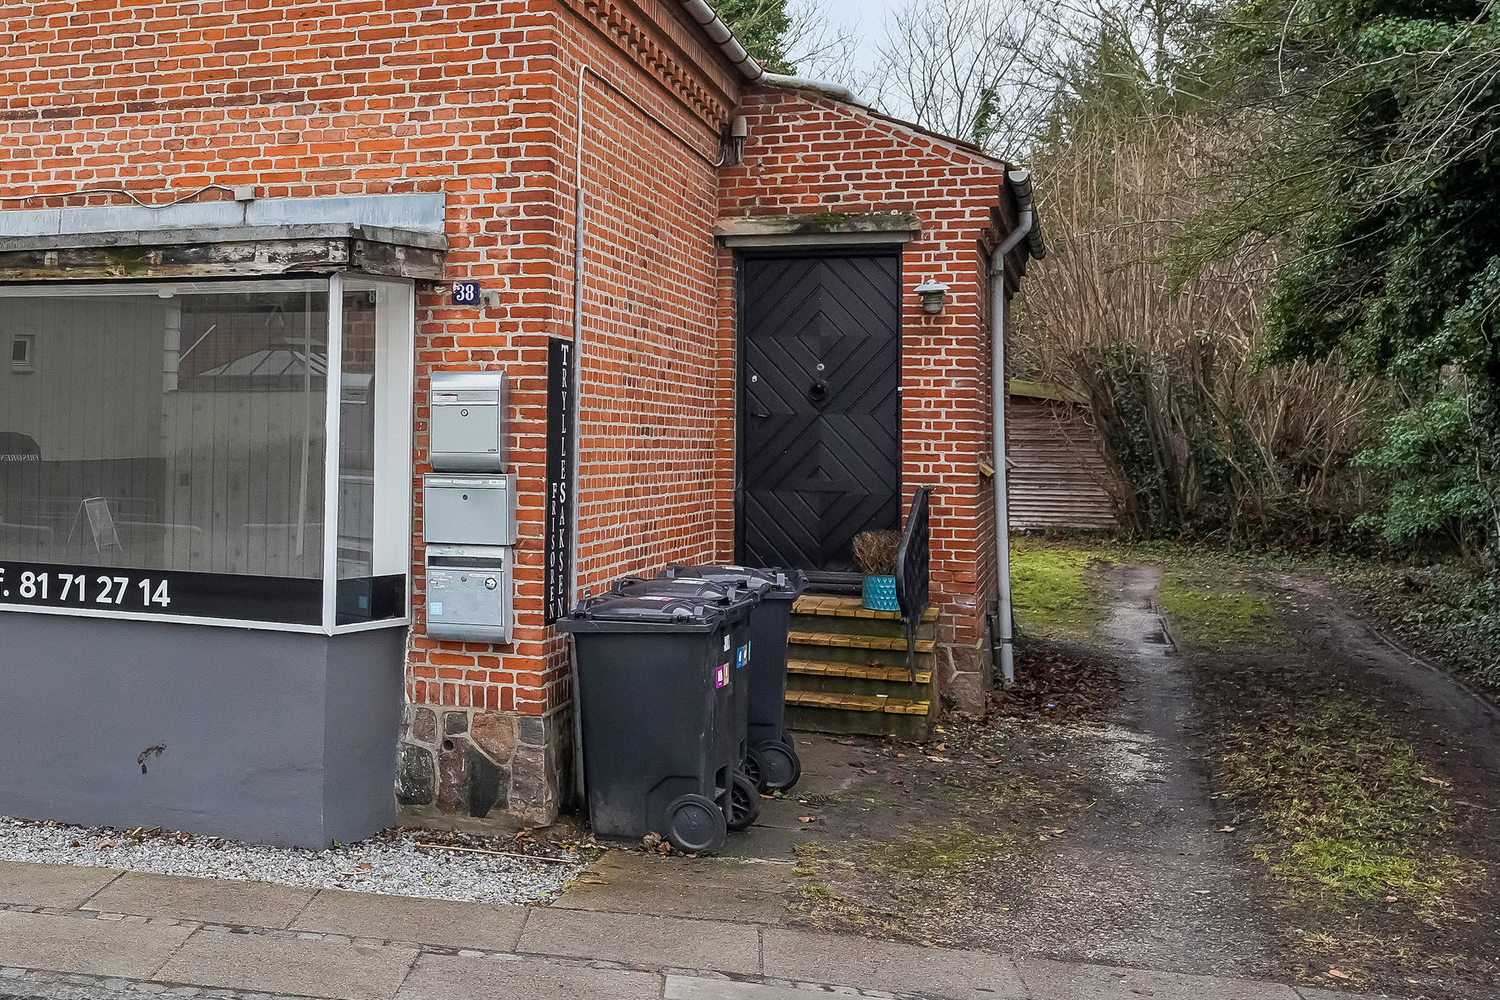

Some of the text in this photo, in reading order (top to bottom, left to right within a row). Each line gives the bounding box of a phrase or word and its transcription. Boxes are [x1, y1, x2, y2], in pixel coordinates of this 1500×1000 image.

[456, 284, 474, 301] 38
[557, 343, 569, 618] TRYLLESAKSEN
[19, 571, 49, 600] 81
[58, 573, 86, 602] 71
[95, 575, 129, 605] 27
[138, 578, 171, 608] 14
